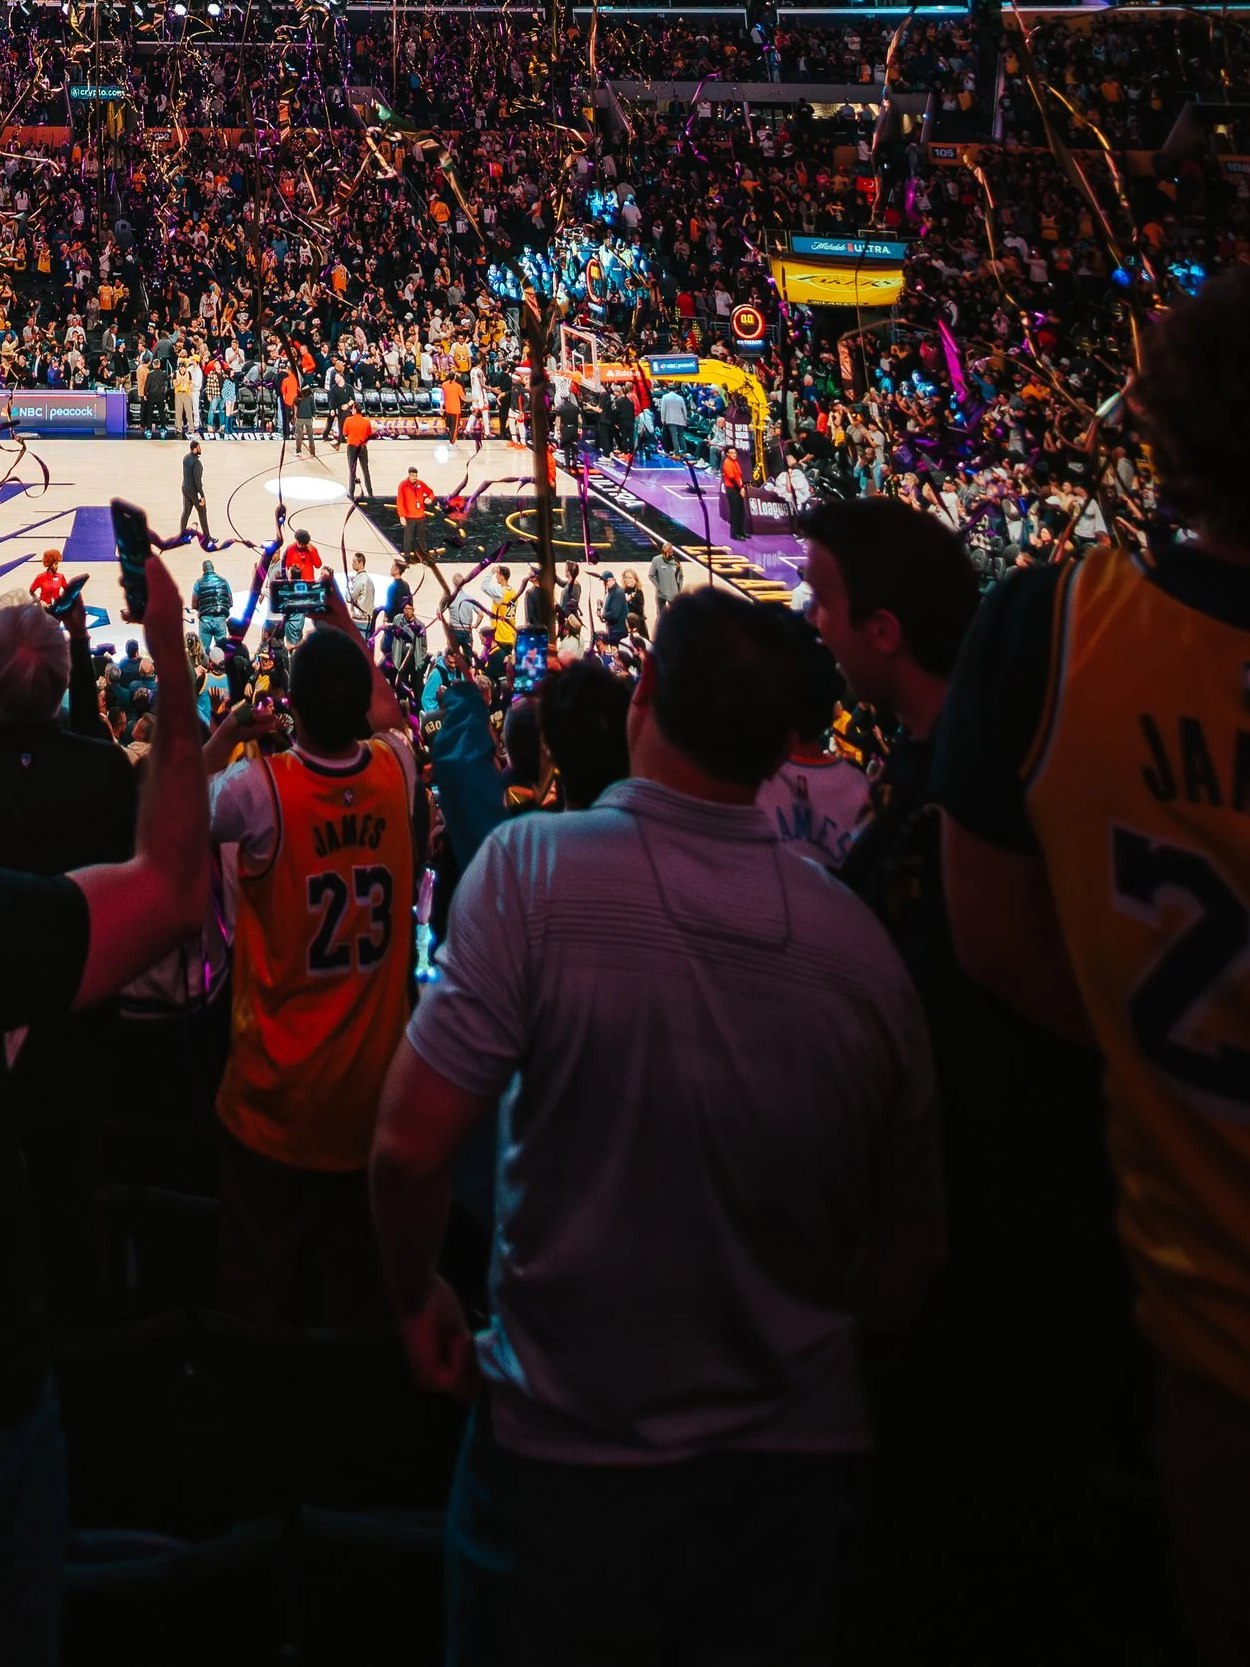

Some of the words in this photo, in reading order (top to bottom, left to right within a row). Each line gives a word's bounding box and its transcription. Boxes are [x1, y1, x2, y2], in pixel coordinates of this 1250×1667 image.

[934, 148, 955, 158] 105
[19, 407, 43, 417] NBC
[49, 405, 94, 420] peacock
[206, 432, 284, 442] PLAYOFFS
[313, 813, 387, 859] JAMES
[306, 863, 394, 977] 23
